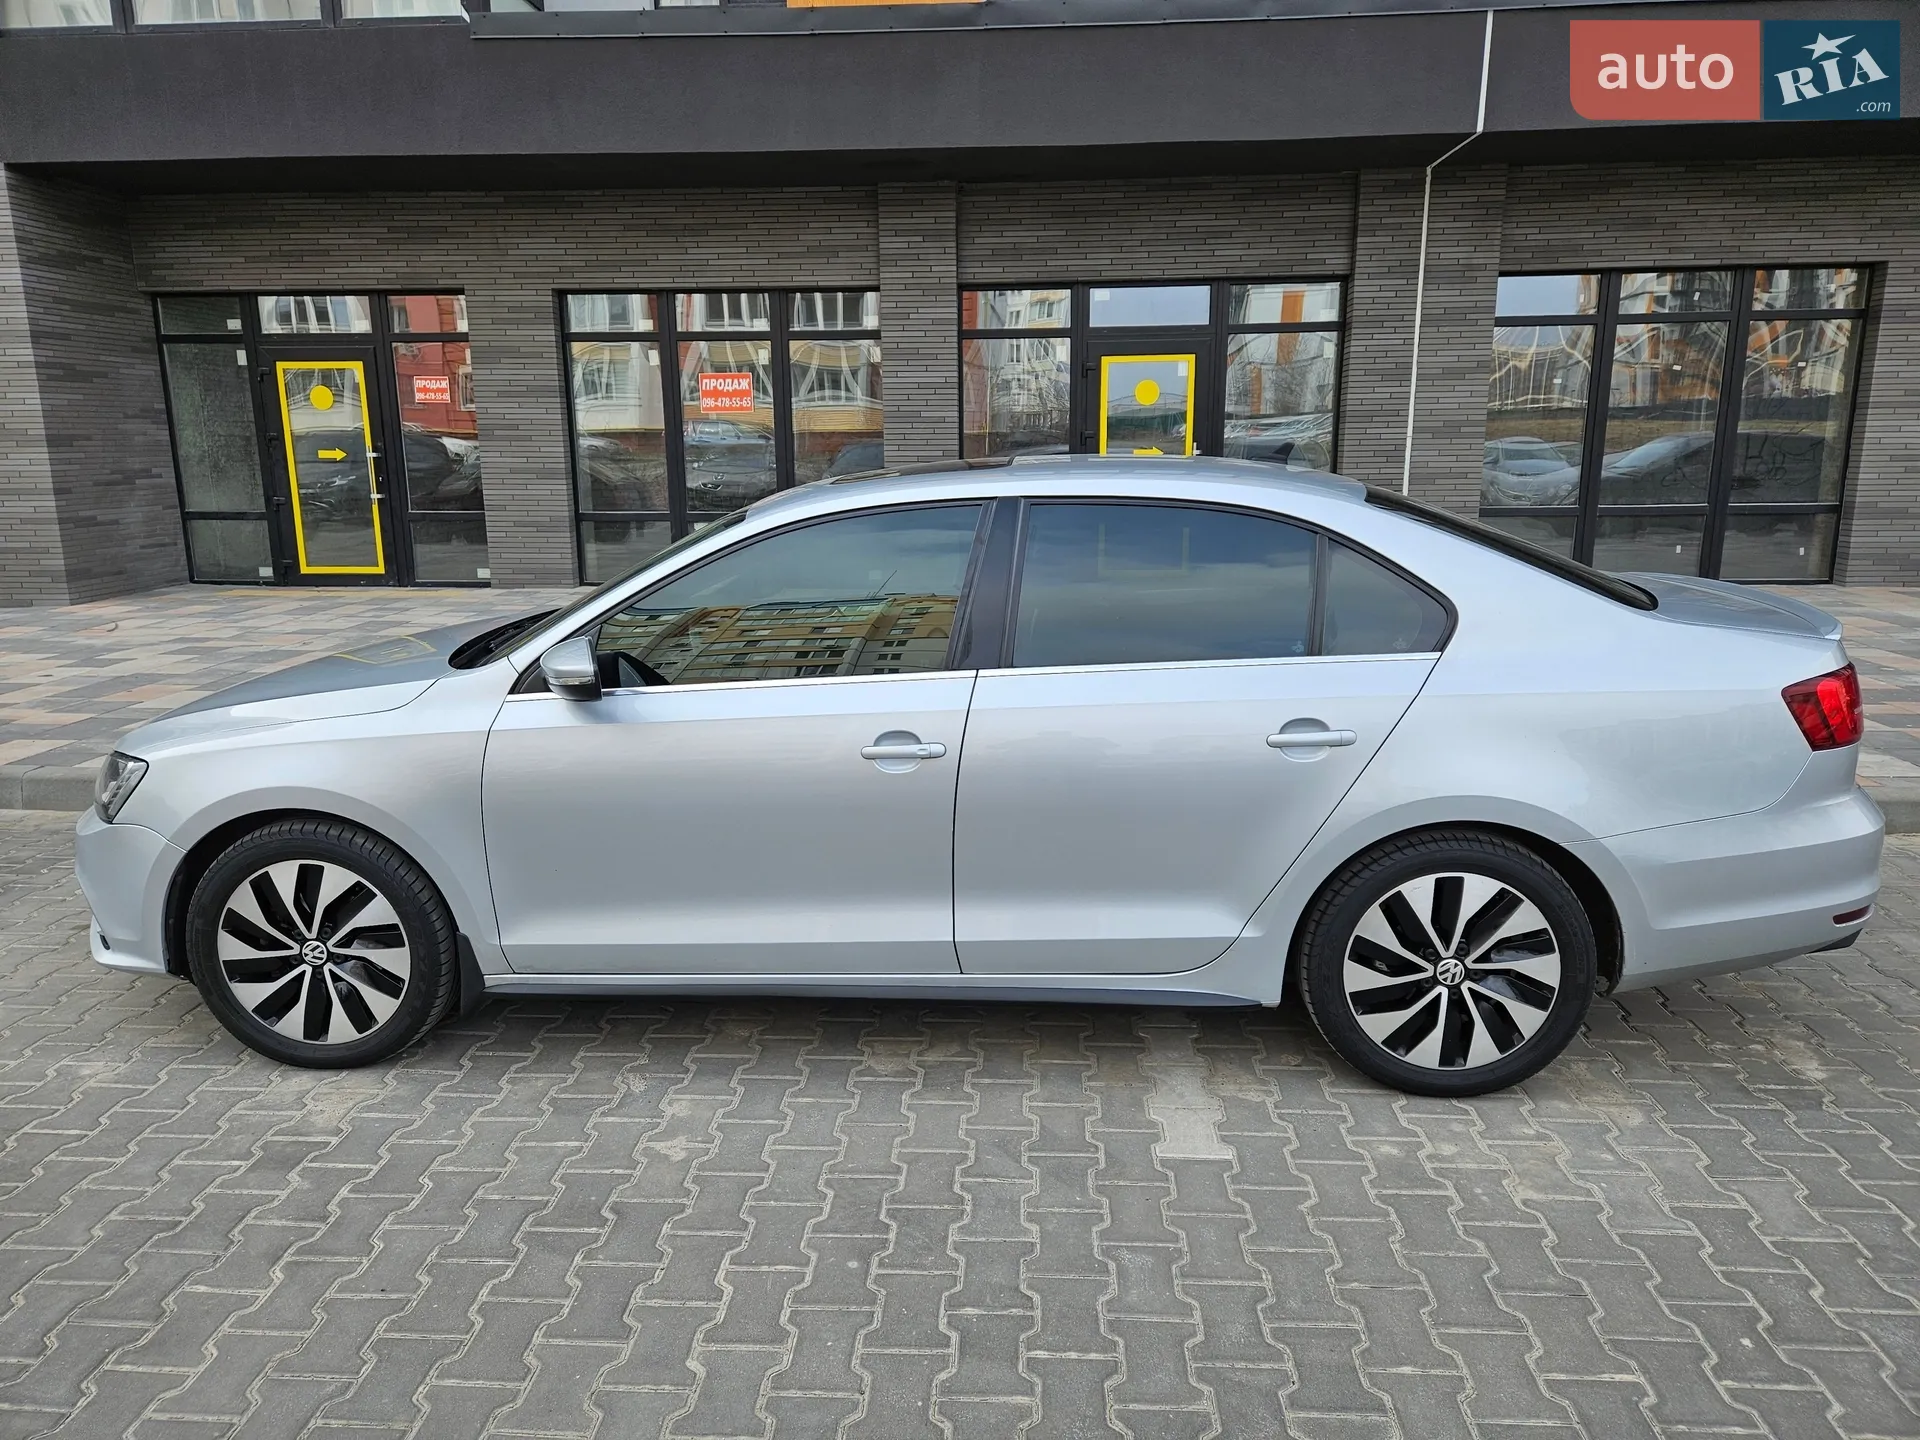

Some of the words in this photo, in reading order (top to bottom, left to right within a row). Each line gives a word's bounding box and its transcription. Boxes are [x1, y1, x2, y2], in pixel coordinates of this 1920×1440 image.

[416, 380, 448, 389] ПРОДАЖ
[702, 378, 750, 392] ПРОДАЖ
[702, 397, 752, 408] 096-478-55-65
